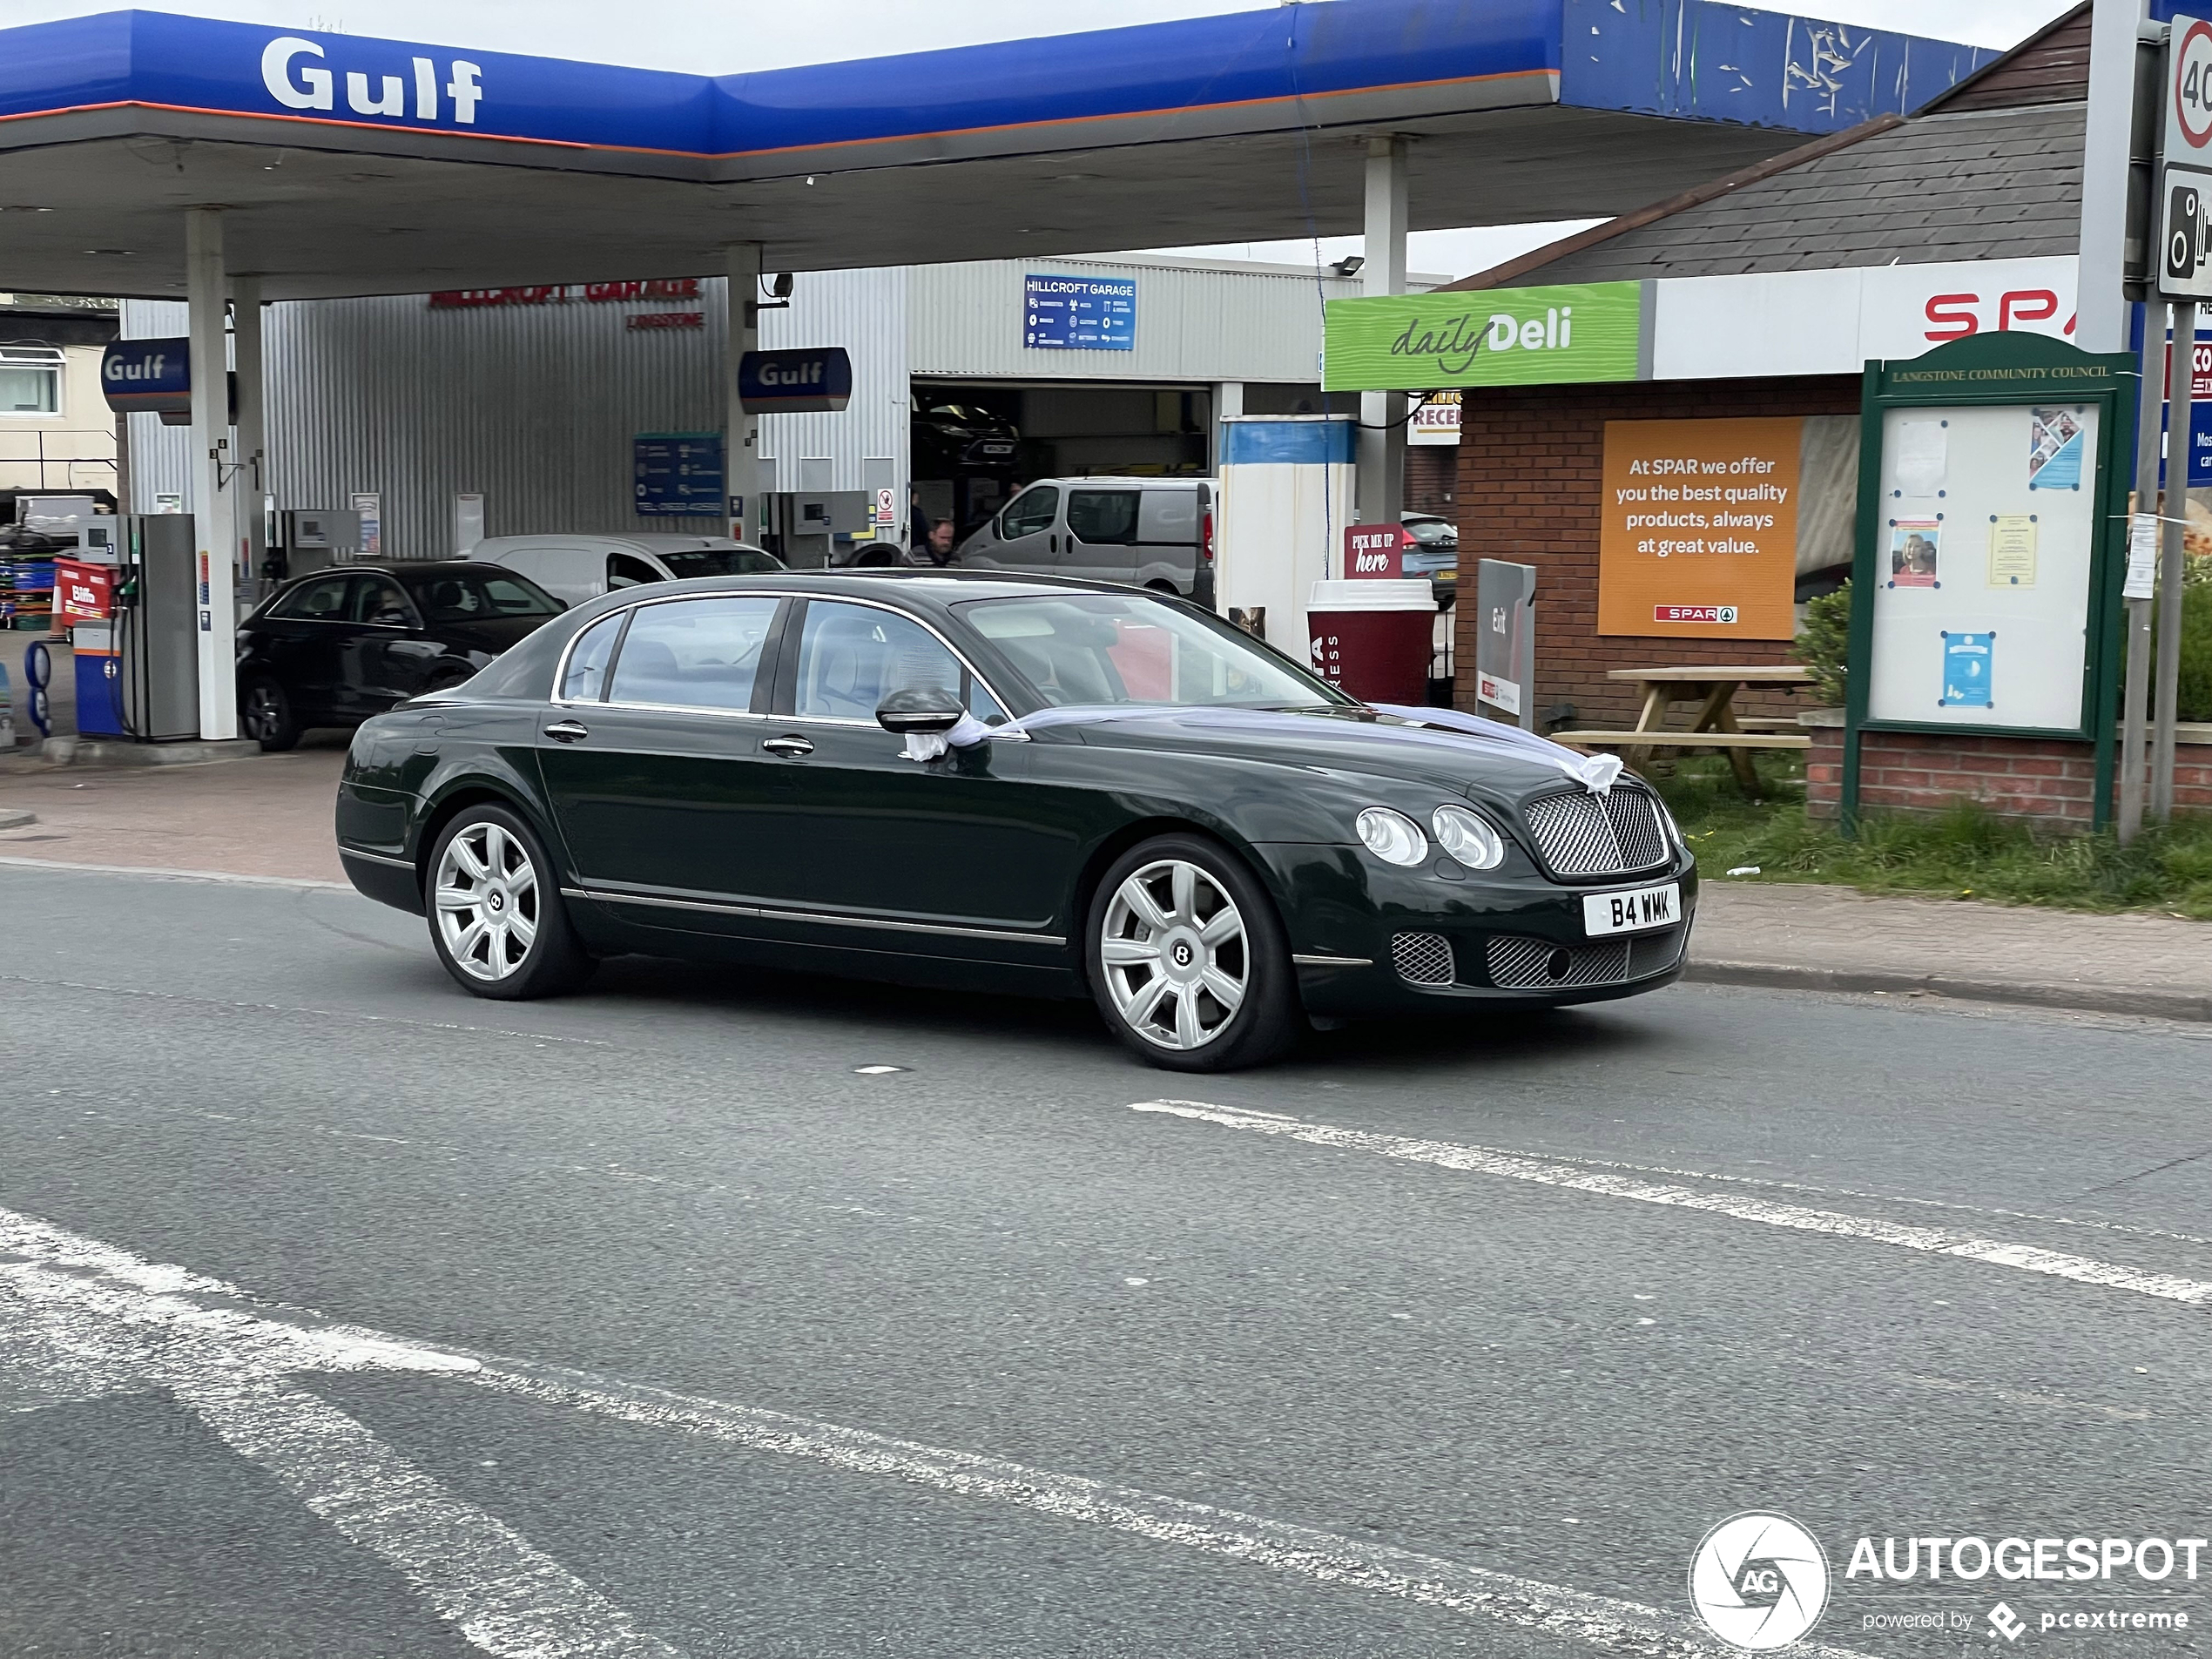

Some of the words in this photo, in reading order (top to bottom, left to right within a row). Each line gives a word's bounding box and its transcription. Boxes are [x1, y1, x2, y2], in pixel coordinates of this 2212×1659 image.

[261, 37, 482, 124] Gulf
[1028, 280, 1089, 293] HILLCROFT
[1089, 284, 1134, 296] GARAGE
[1924, 289, 2077, 341] SP
[1391, 314, 1495, 374] daily
[1488, 307, 1571, 351] Deli
[105, 354, 165, 381] Gulf
[758, 361, 823, 386] Gulf
[1892, 370, 1966, 382] LANGSTONE
[1968, 368, 2047, 381] COMMUNITY
[2051, 367, 2110, 378] COUNCIL
[1629, 459, 1649, 475] At
[1652, 458, 1698, 475] SPAR
[1702, 462, 1726, 475] we
[1730, 457, 1775, 474] offer
[1616, 488, 1647, 504] you
[1650, 484, 1679, 501] the
[1683, 484, 1722, 501] best
[1724, 483, 1787, 504] quality
[1626, 510, 1710, 531] products,
[1712, 510, 1774, 531] always
[1352, 534, 1370, 550] PICK
[1370, 534, 1383, 549] ME
[1384, 533, 1393, 548] UP
[1637, 538, 1656, 553] at
[1657, 538, 1704, 557] great
[1708, 536, 1760, 554] value.
[1355, 549, 1389, 573] here
[1669, 609, 1716, 619] SPAR
[1610, 896, 1637, 927] B4
[1641, 891, 1670, 923] WMK
